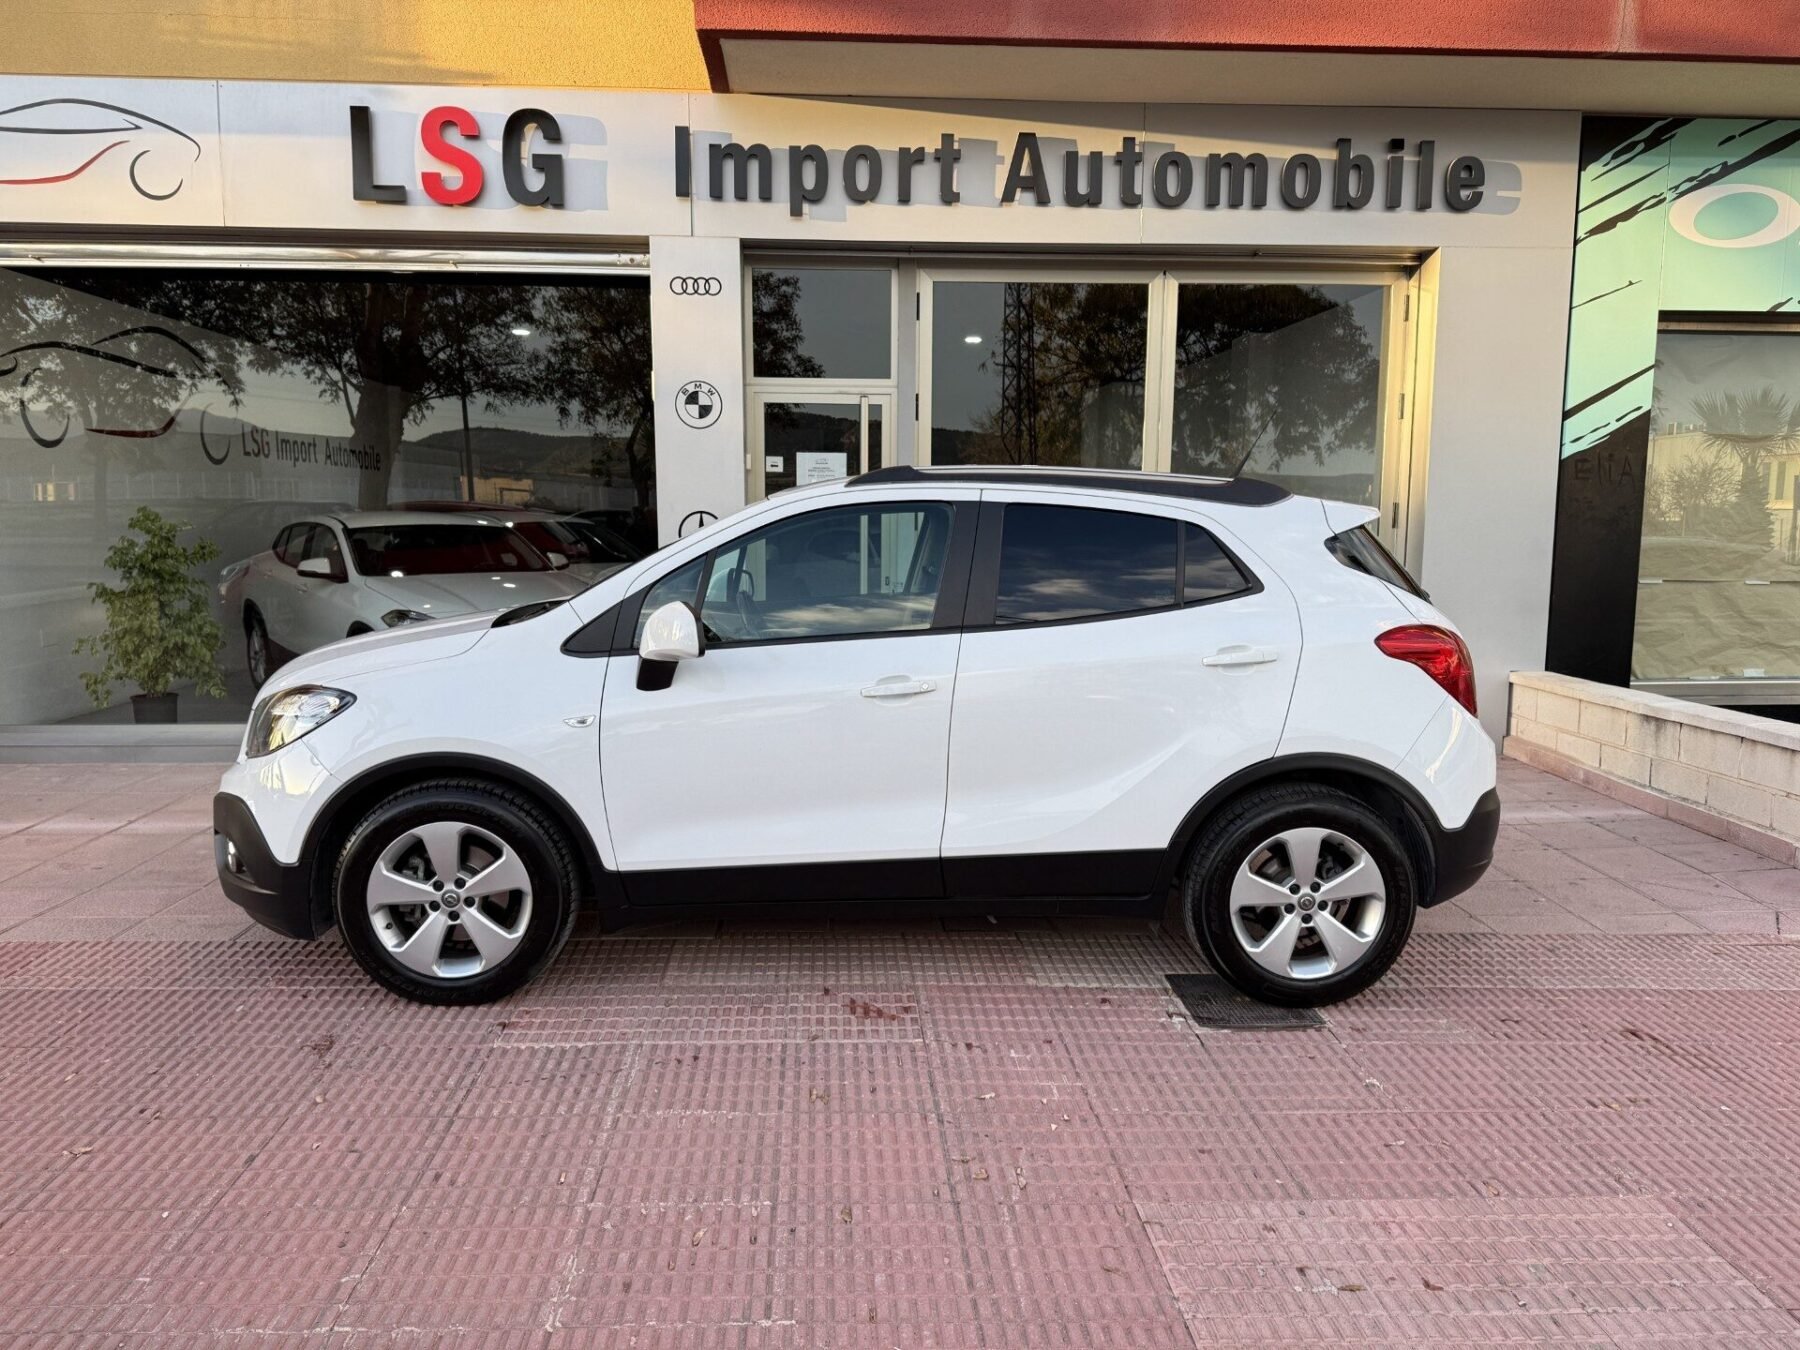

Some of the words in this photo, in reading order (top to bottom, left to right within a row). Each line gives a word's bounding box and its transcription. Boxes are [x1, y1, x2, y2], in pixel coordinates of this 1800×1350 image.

[349, 105, 564, 208] LSG
[674, 125, 962, 218] Import
[1001, 131, 1486, 211] Automobile
[681, 383, 716, 396] BMW
[242, 423, 270, 459] LSG
[275, 430, 318, 468] Import
[324, 437, 381, 472] Automobile
